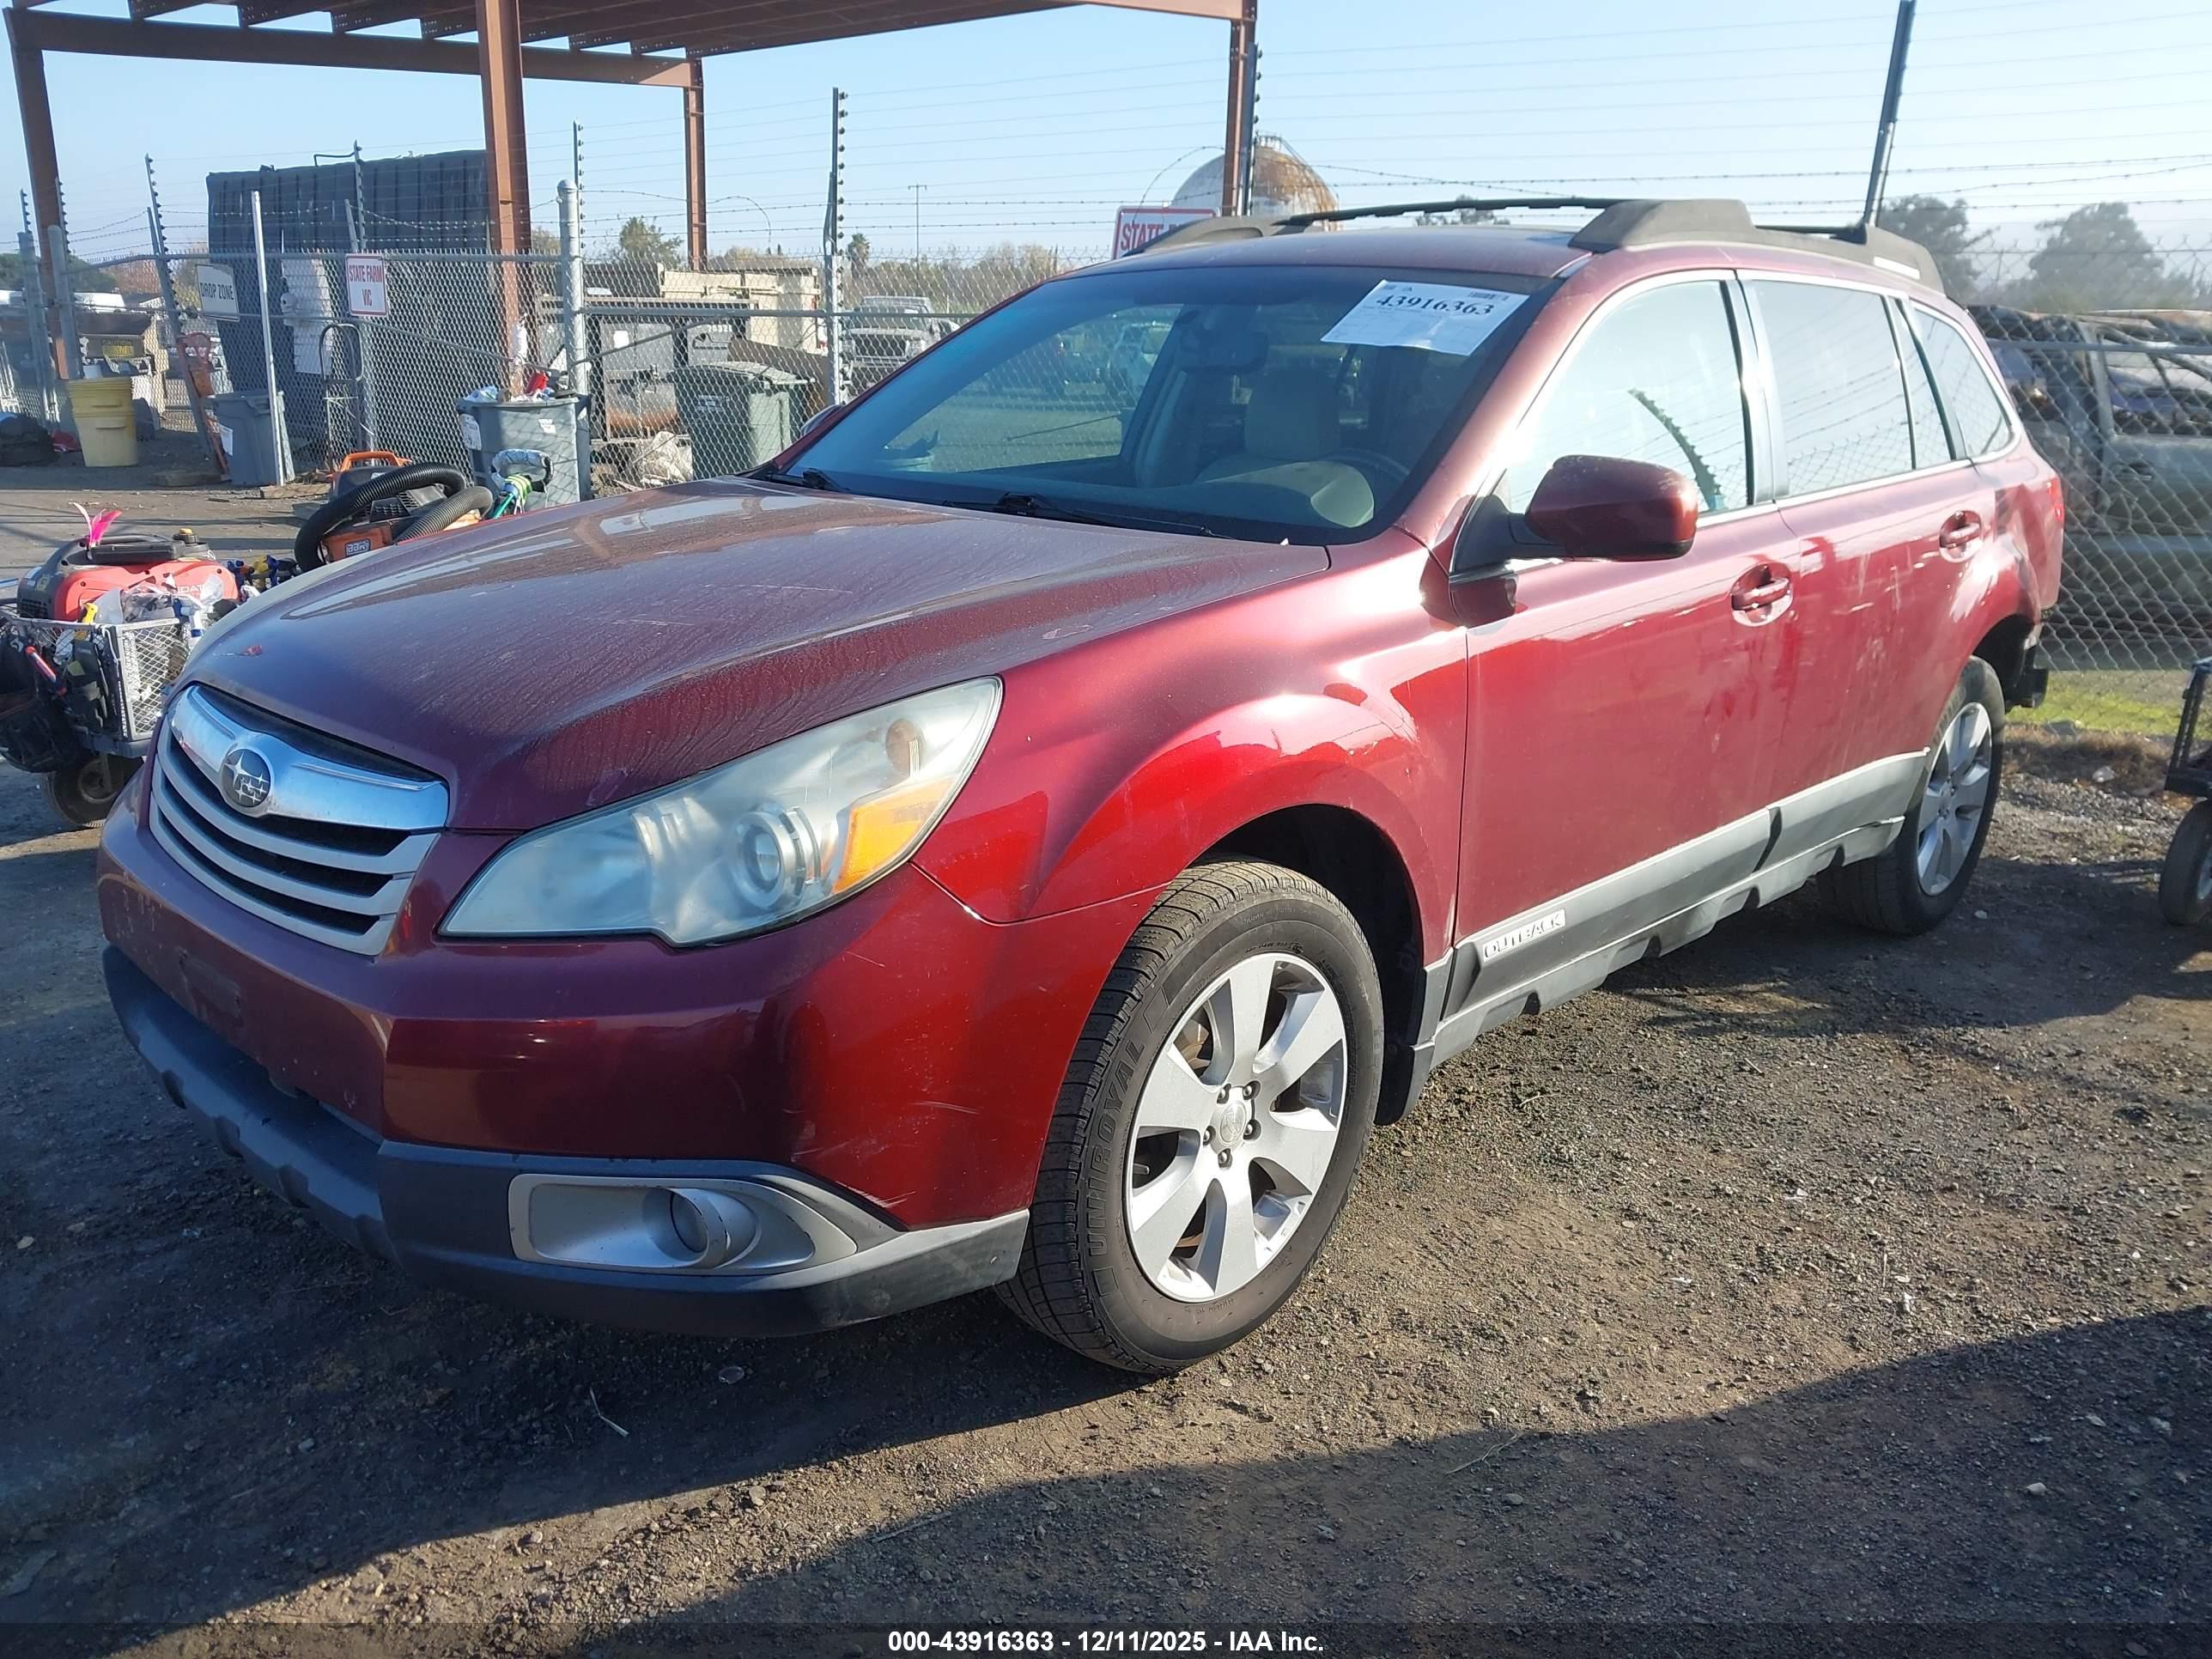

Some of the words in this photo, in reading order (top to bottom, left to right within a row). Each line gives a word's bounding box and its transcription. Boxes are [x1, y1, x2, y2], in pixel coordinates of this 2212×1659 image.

[349, 264, 366, 283] STATE
[367, 264, 383, 283] FARM
[199, 282, 216, 298] DROP
[217, 283, 234, 301] ZONE
[362, 288, 373, 307] VIC
[1376, 294, 1494, 316] 43916363
[1483, 911, 1564, 959] OUTBACK
[1086, 1039, 1146, 1257] UNIROYAL
